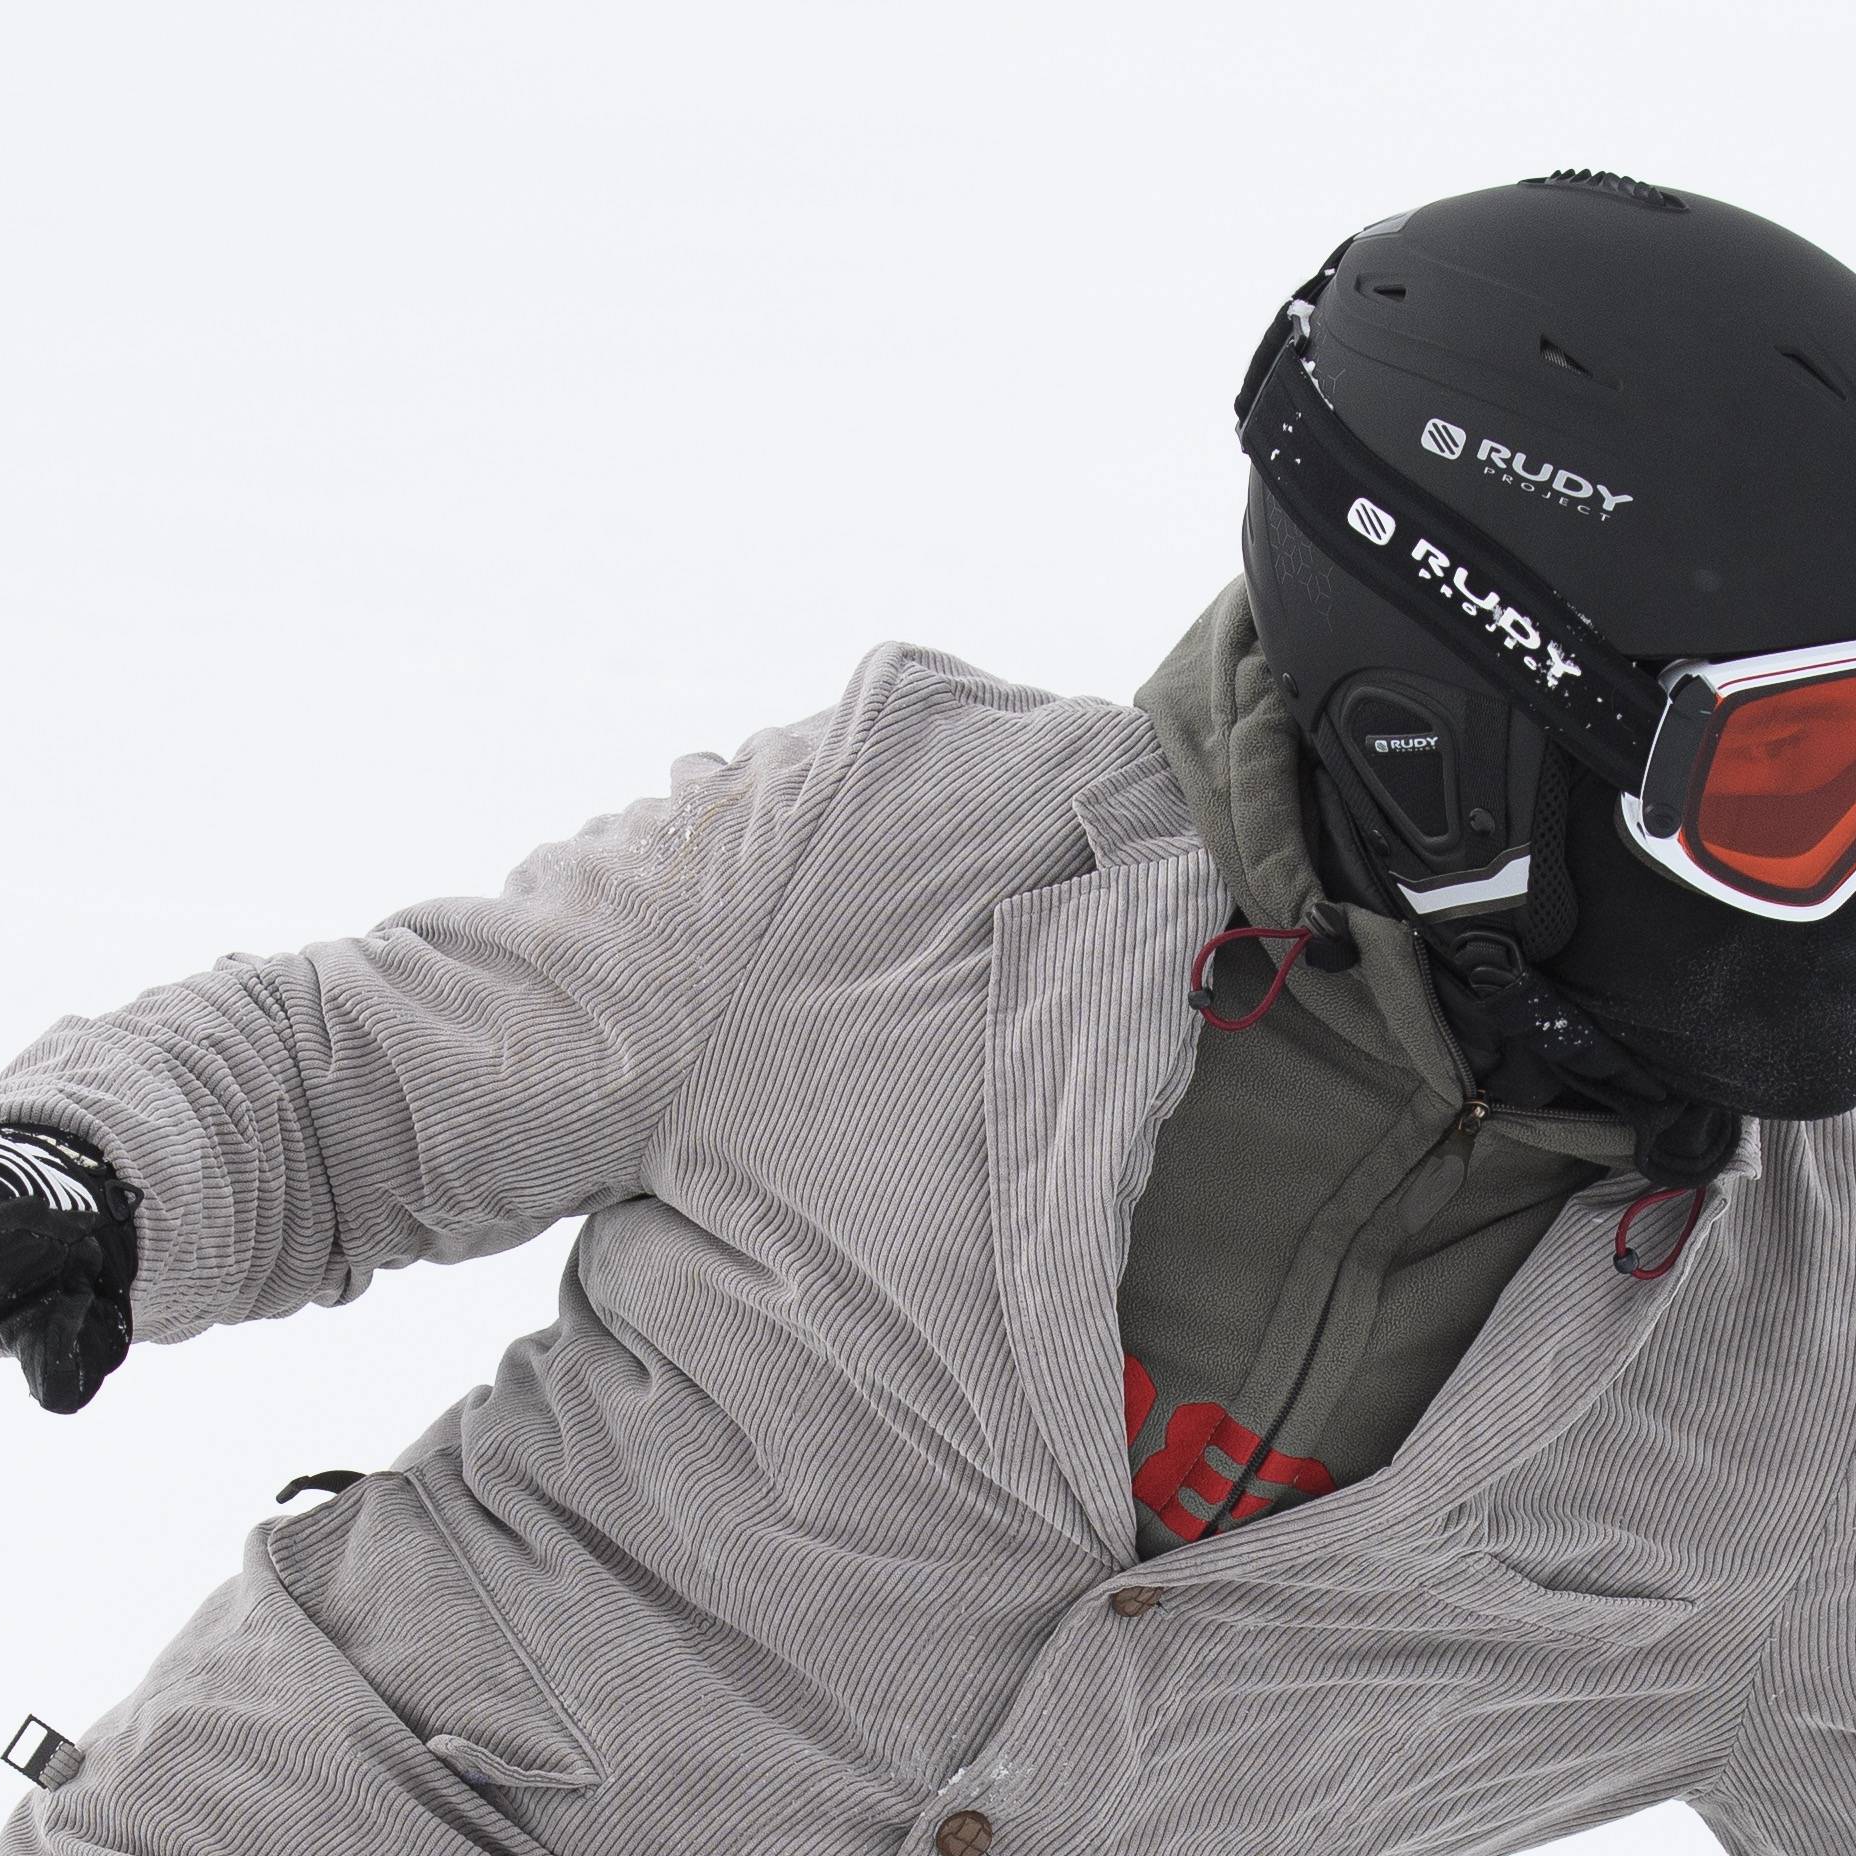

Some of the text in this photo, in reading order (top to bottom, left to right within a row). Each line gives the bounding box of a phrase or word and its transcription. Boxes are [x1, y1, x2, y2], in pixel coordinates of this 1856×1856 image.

[1476, 438, 1634, 513] RUDY
[1483, 466, 1612, 522] PROJECT
[1410, 538, 1582, 678] RUDY
[1390, 736, 1439, 749] RUDY
